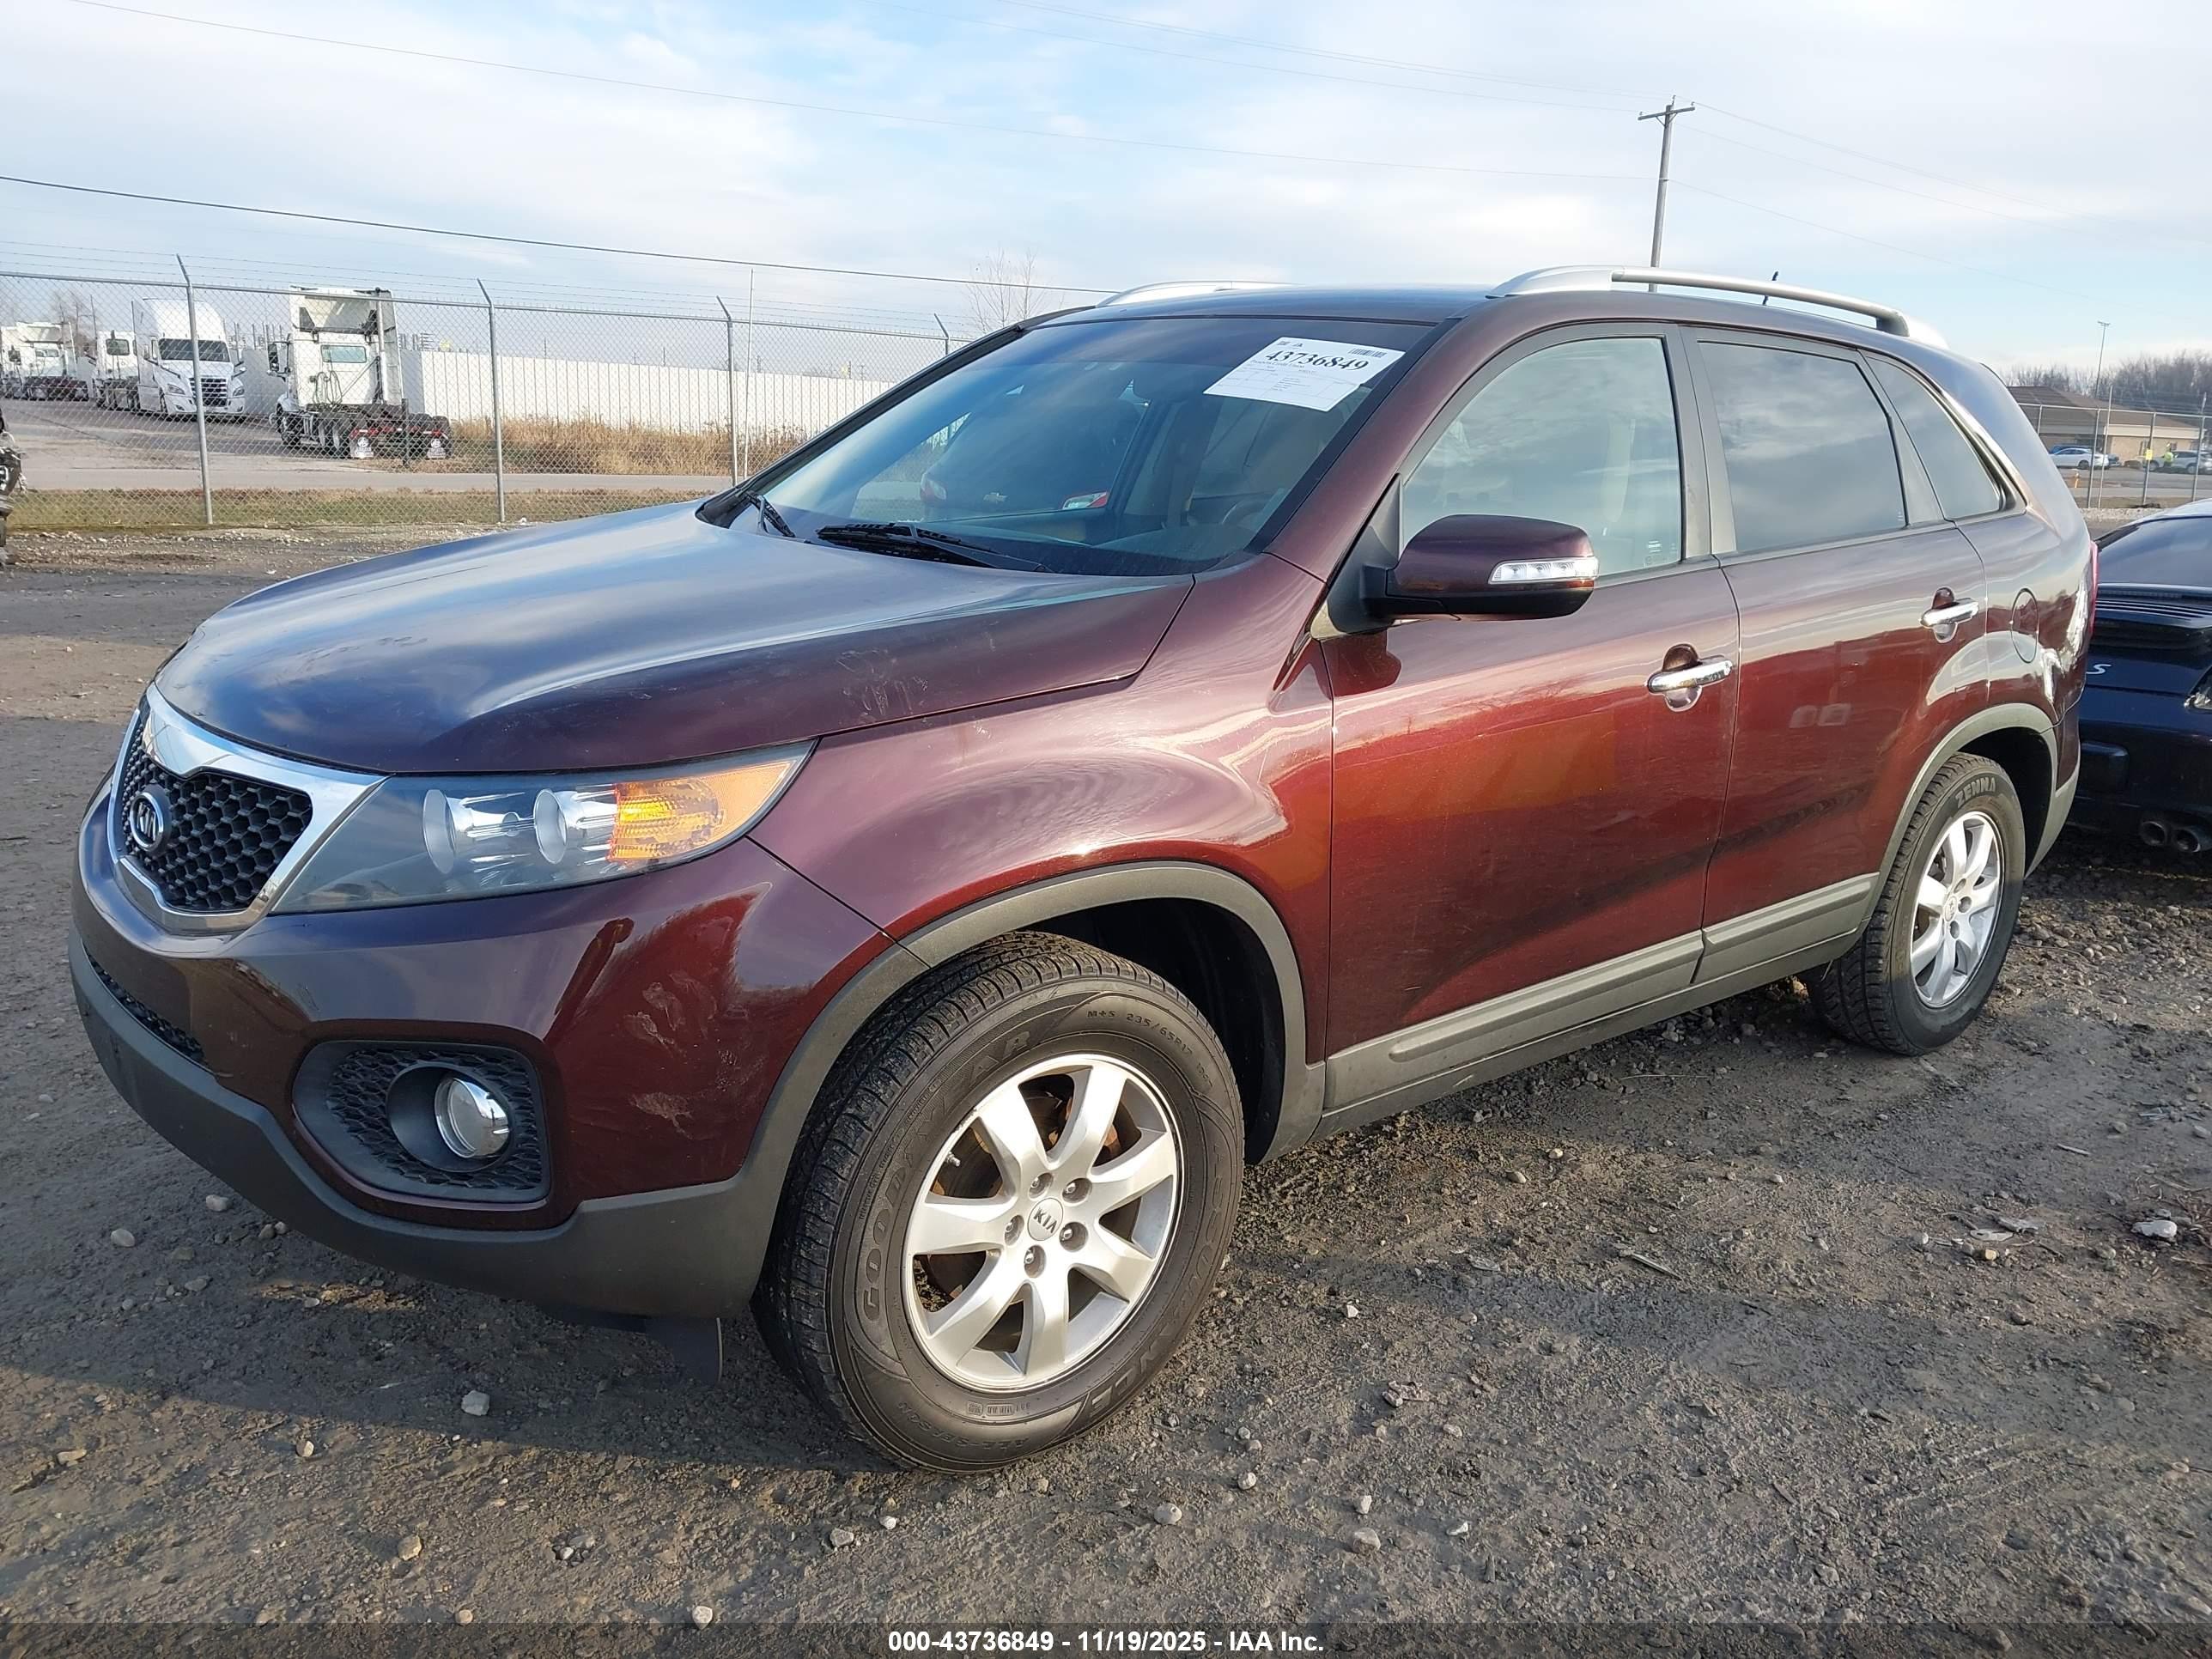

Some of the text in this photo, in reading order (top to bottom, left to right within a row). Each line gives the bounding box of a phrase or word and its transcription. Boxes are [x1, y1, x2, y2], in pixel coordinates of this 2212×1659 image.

[1266, 350, 1369, 370] 43736849
[1955, 776, 1996, 808] ZENNA
[1086, 1010, 1117, 1018] M+S
[1125, 1012, 1194, 1055] 235/65R17
[1033, 1206, 1057, 1234] KIA
